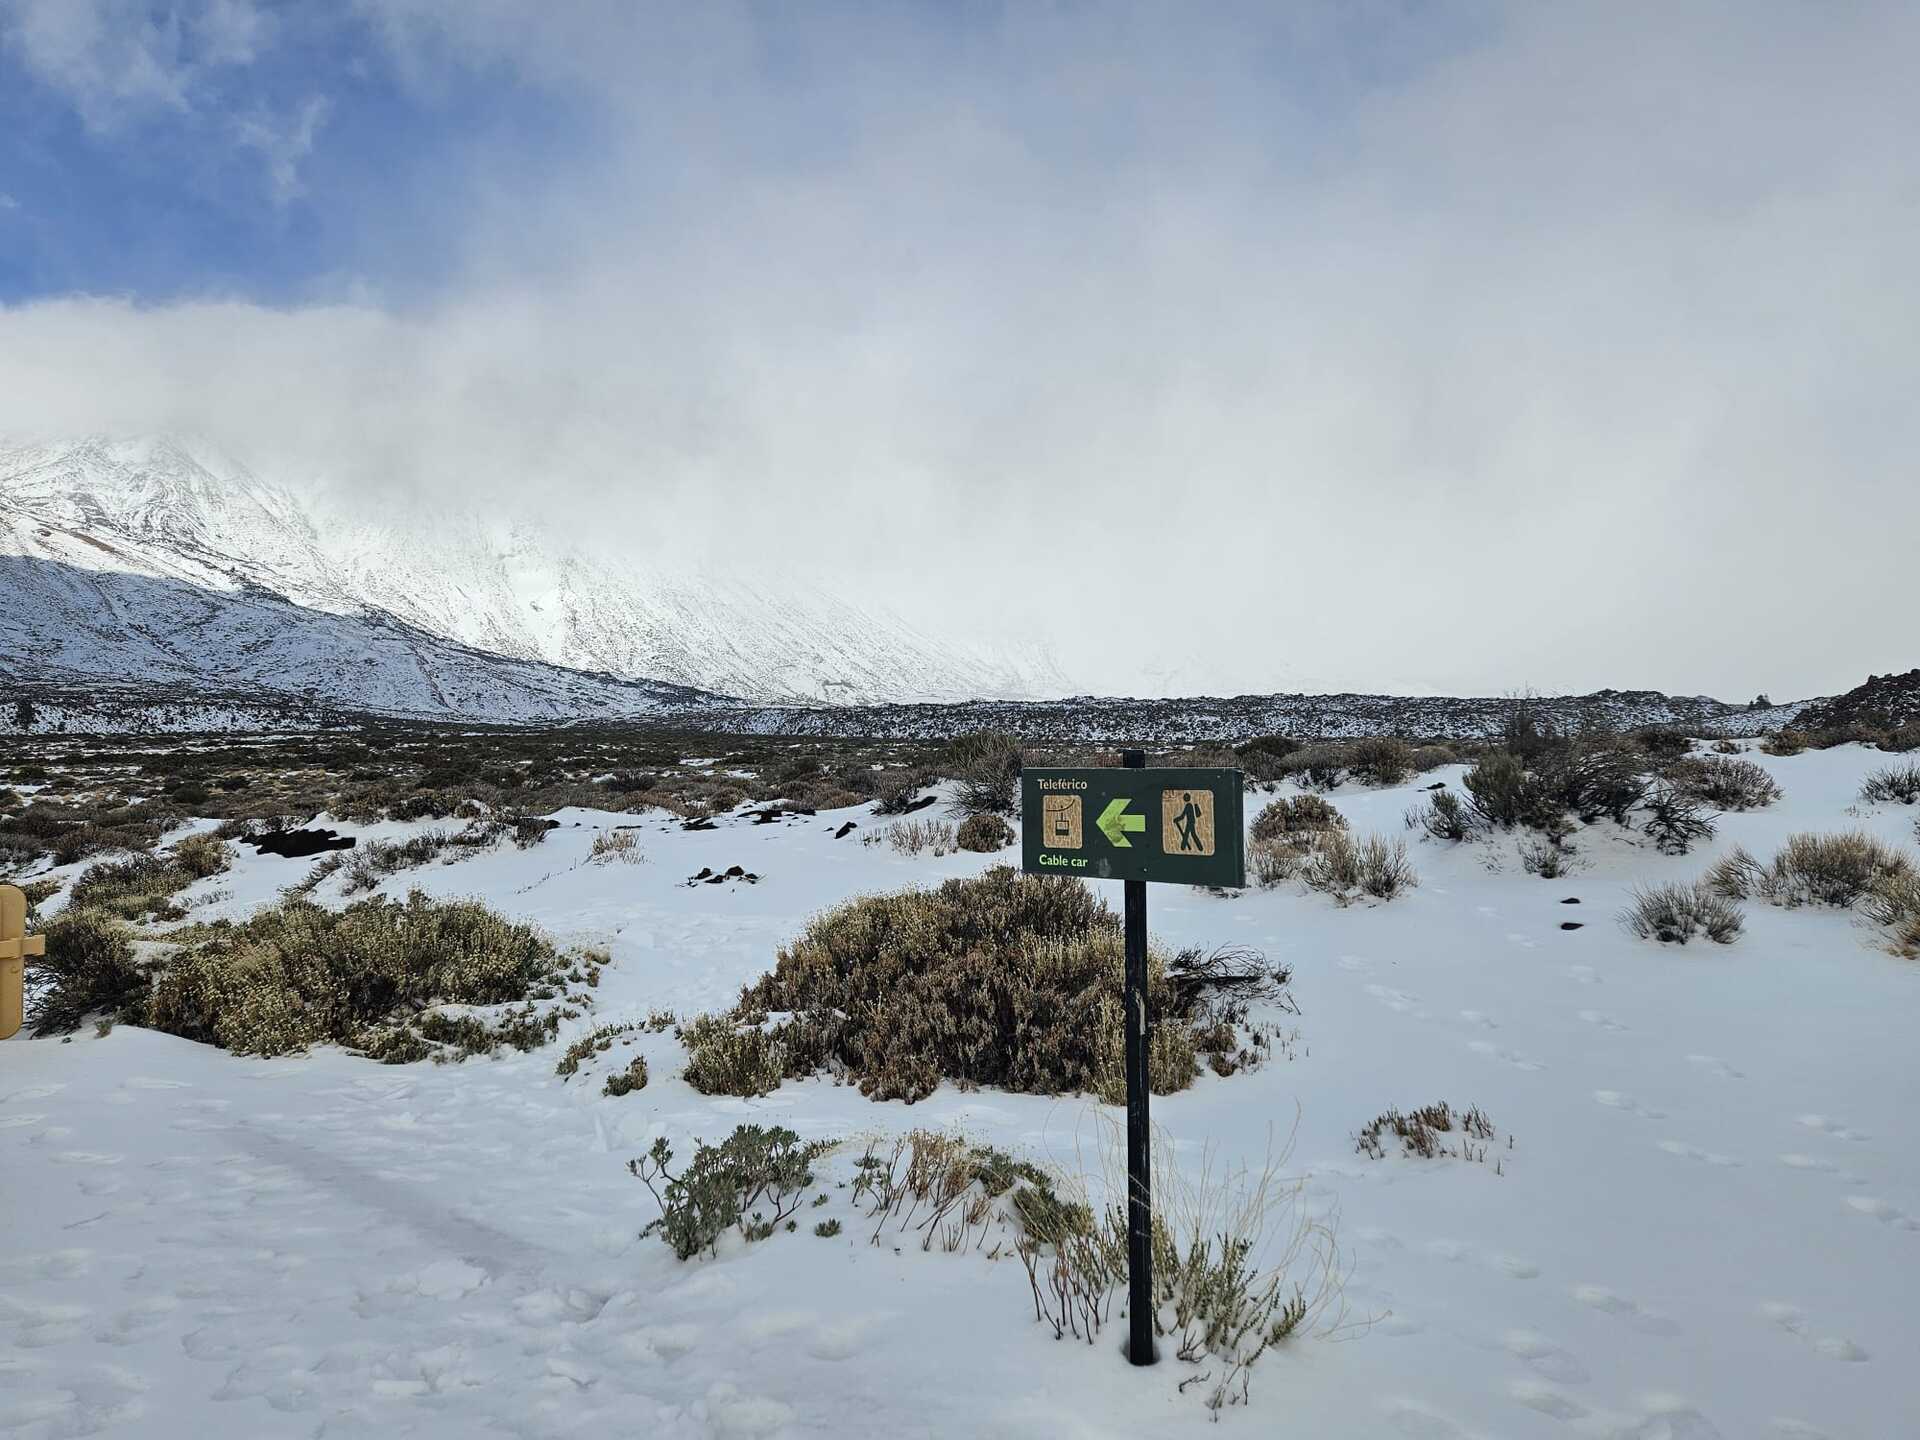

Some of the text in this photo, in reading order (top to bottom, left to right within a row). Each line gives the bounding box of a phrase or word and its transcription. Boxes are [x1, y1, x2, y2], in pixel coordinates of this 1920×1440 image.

[1037, 778, 1088, 790] Teleférico
[1039, 854, 1088, 867] Cable car
